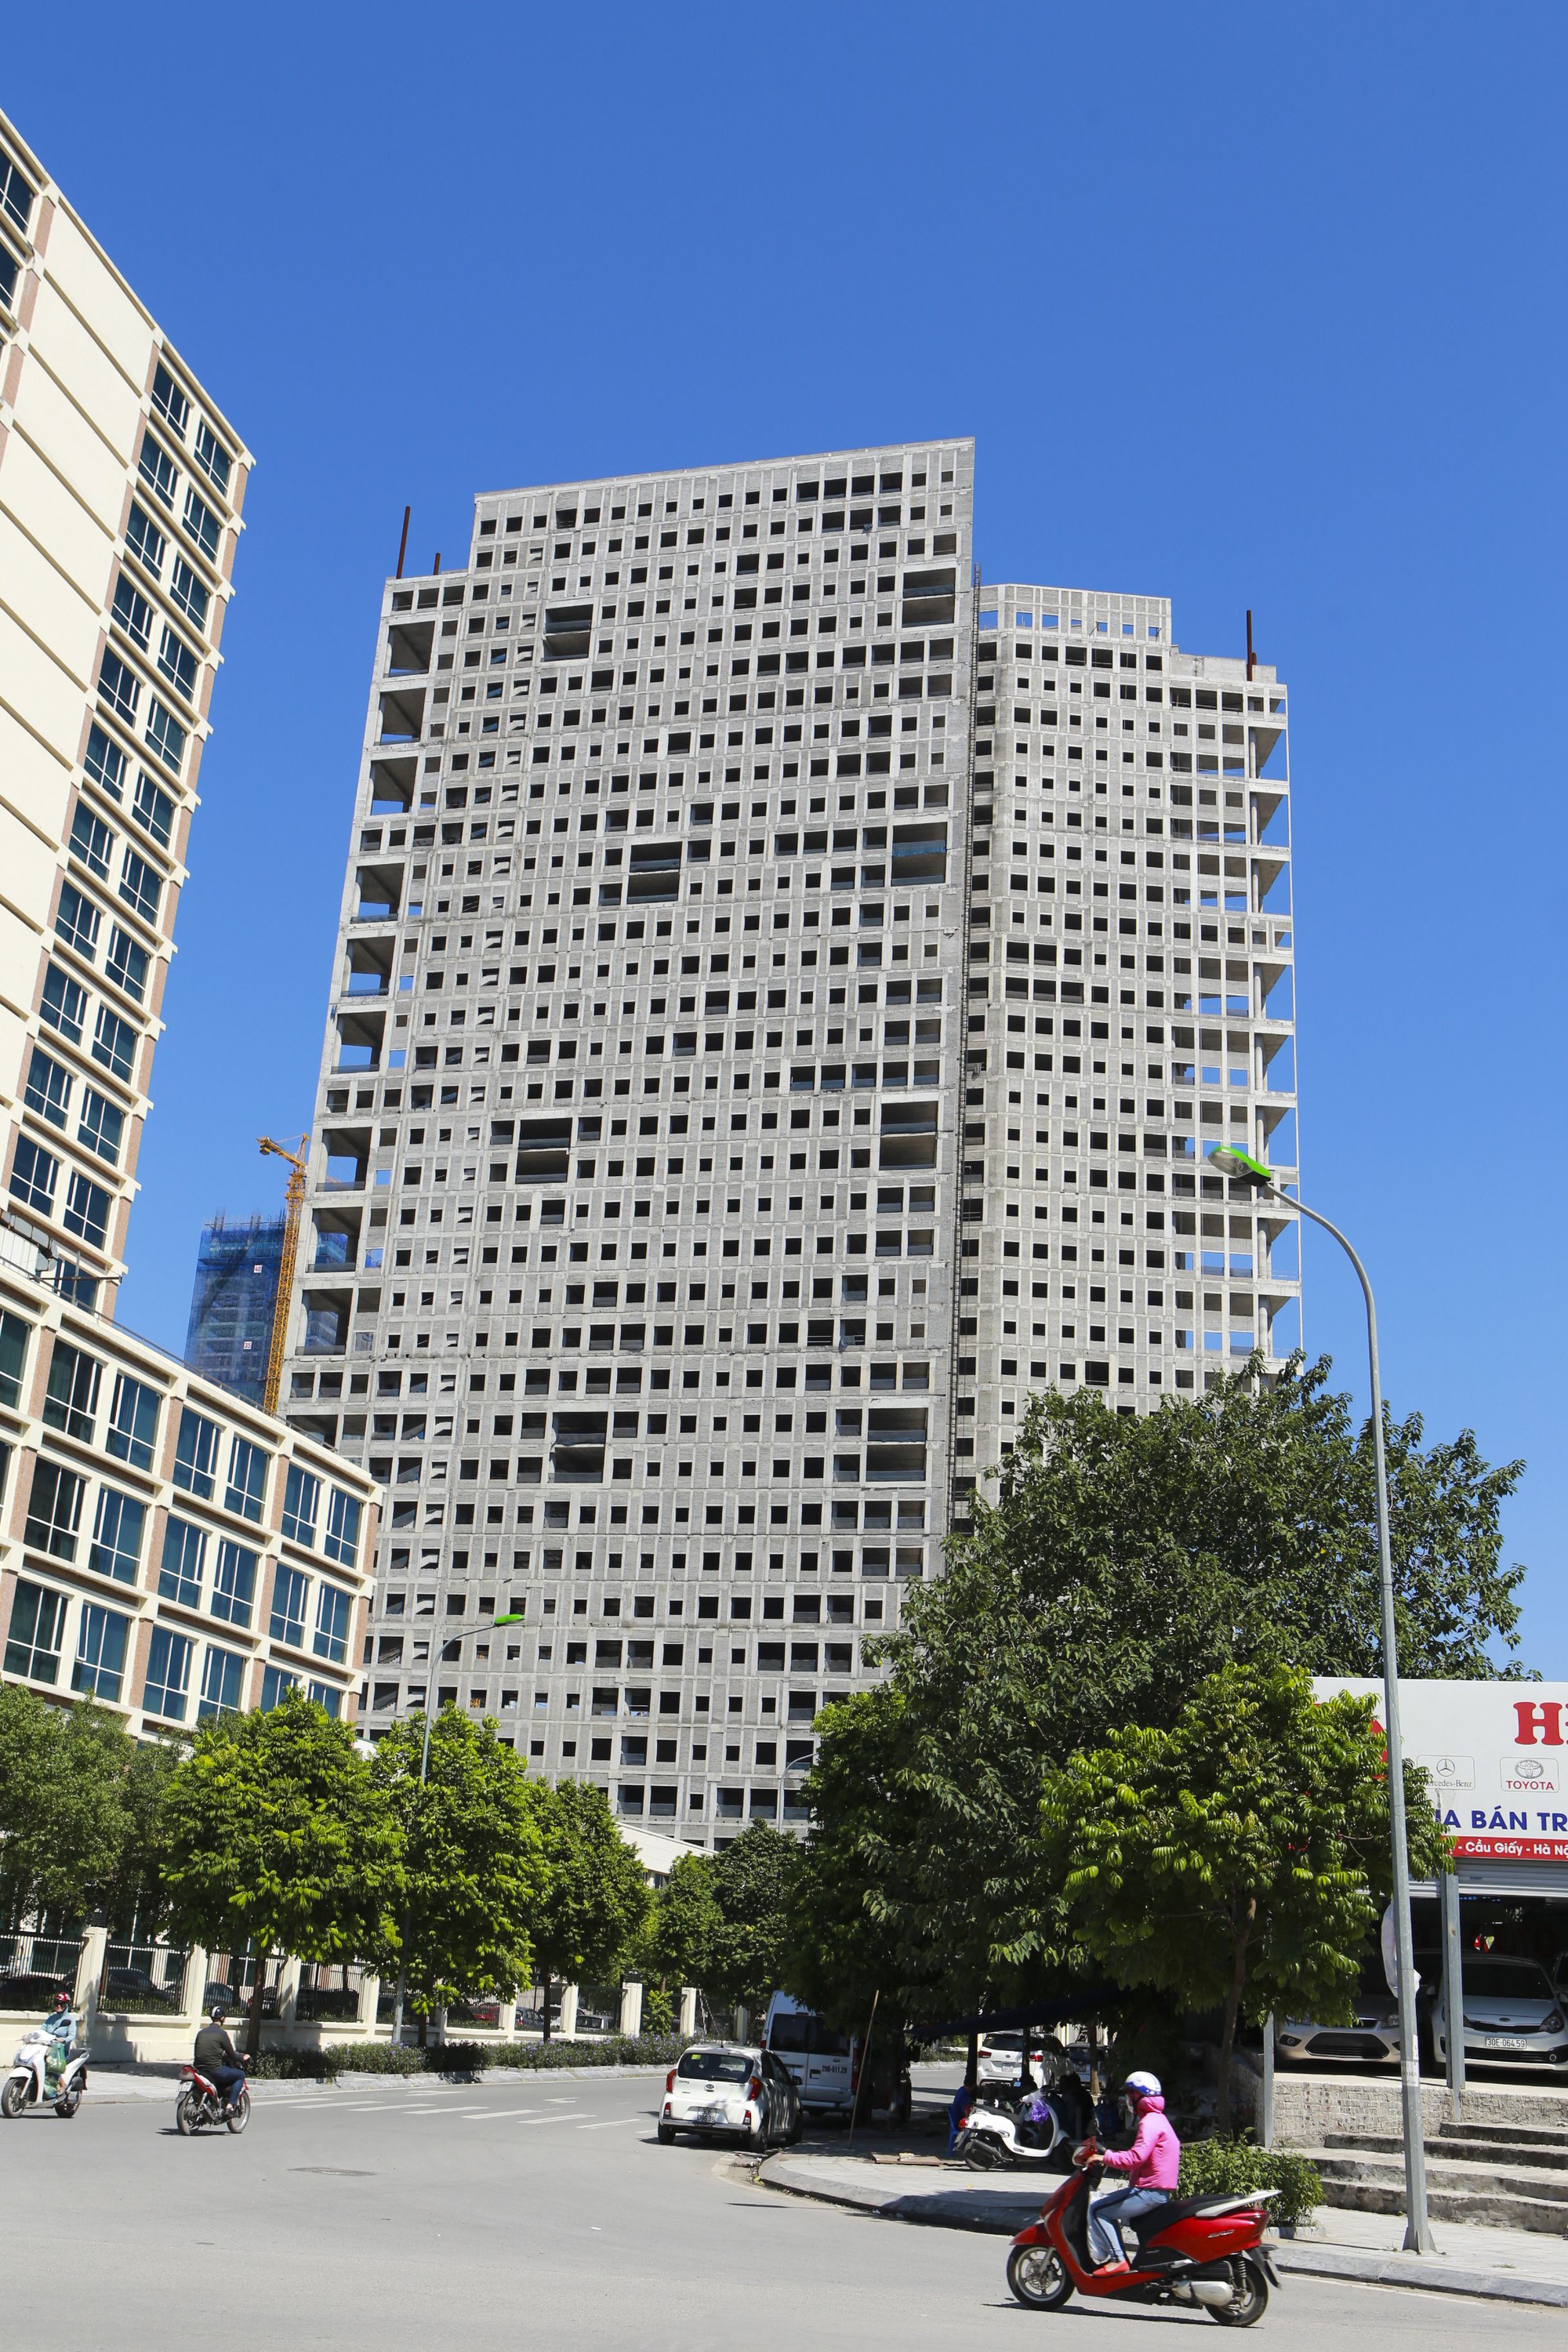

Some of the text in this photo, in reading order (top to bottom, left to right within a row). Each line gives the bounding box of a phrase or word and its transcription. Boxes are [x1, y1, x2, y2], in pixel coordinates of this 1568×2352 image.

[1513, 1702, 1568, 1746] H
[1425, 1779, 1472, 1788] ercedes-Benz
[1506, 1780, 1555, 1791] TOYOTA
[1472, 1805, 1527, 1831] BÁN
[1465, 1838, 1491, 1853] Cầu
[1494, 1840, 1523, 1856] Giấy
[1534, 1842, 1551, 1855] Hà
